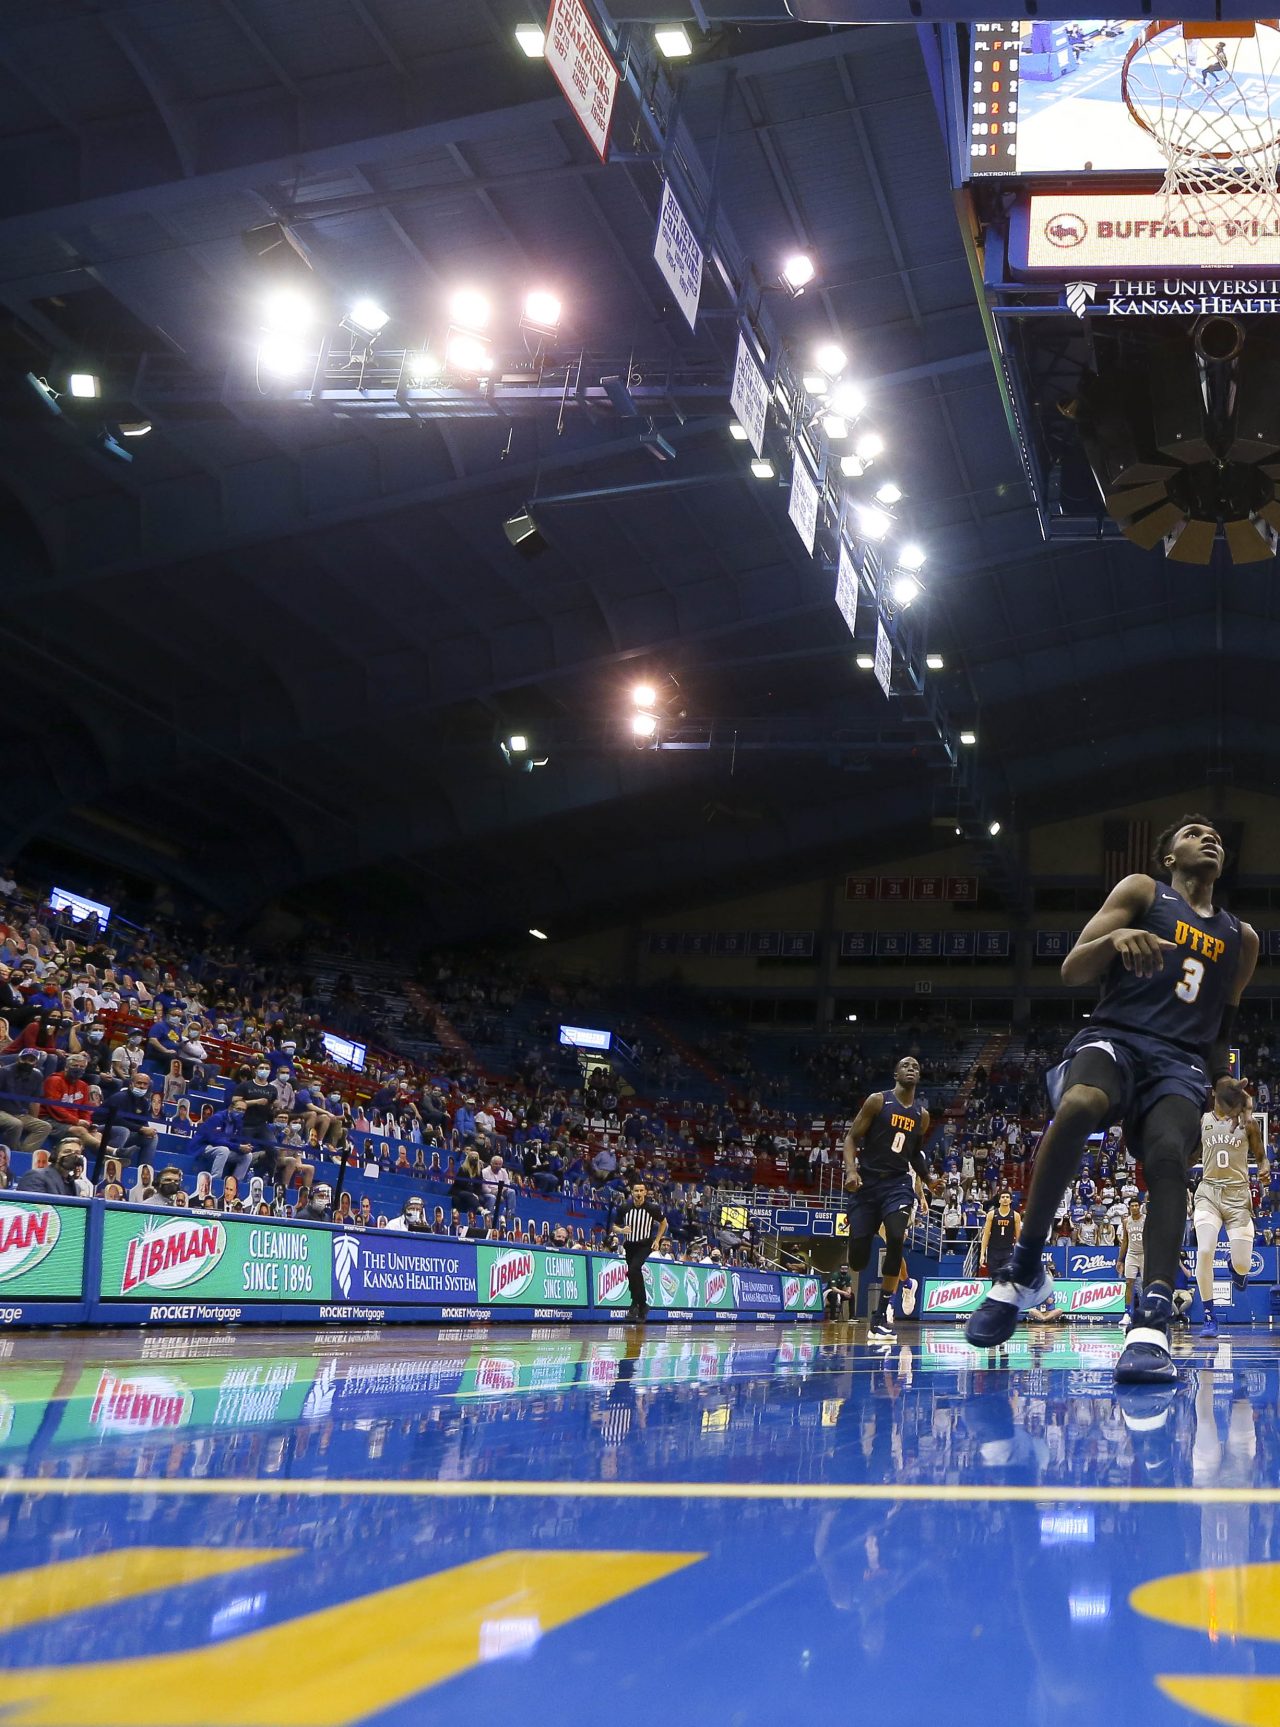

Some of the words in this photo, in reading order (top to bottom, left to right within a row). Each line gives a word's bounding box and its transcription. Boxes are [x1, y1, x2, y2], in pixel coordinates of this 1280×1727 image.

[558, 1, 610, 105] CHAMPIONS
[583, 22, 610, 80] EIGHT
[974, 42, 990, 51] PL
[994, 41, 1002, 50] F
[991, 102, 999, 114] 2
[989, 144, 996, 156] 1
[667, 191, 680, 224] BIG
[662, 205, 700, 285] CHAMPIONS
[1108, 279, 1156, 297] THE
[1107, 298, 1198, 316] KANSAS
[1175, 919, 1225, 963] UTEP
[1175, 956, 1205, 1004] 3
[890, 1113, 915, 1132] UTEP
[891, 1131, 906, 1154] 0
[1205, 1134, 1242, 1149] KANSAS
[1216, 1150, 1229, 1169] 0
[750, 1208, 772, 1217] KANSAS
[814, 1212, 833, 1220] GUEST
[1001, 1226, 1005, 1236] 1
[1131, 1233, 1143, 1242] 33
[249, 1229, 308, 1260] CLEANING
[120, 1226, 220, 1291] LIBMAN
[362, 1251, 386, 1270] THE
[387, 1253, 447, 1273] UNIVERSITY
[447, 1259, 459, 1274] OF
[545, 1256, 575, 1278] CLEANING
[1070, 1255, 1116, 1272] Dillons
[243, 1262, 279, 1291] SINCE
[282, 1264, 313, 1293] 1896
[363, 1270, 404, 1290] KANSAS
[406, 1273, 443, 1291] HEALTH
[444, 1275, 477, 1292] SYSTEM
[489, 1254, 531, 1299] LIBMAN
[543, 1279, 561, 1299] SINCE
[562, 1279, 578, 1299] 1896
[705, 1275, 726, 1305] LIBMAN
[784, 1281, 800, 1307] LIBMAN
[804, 1283, 817, 1308] LIBMAN
[928, 1284, 979, 1309] LIBMAN
[1071, 1284, 1122, 1310] LIBMAN
[150, 1306, 196, 1320] ROCKET
[196, 1306, 242, 1322] Mortgage
[319, 1306, 352, 1318] ROCKET
[352, 1307, 385, 1320] Mortgage
[441, 1308, 467, 1318] ROCKET
[466, 1308, 491, 1320] Mortgage
[534, 1309, 554, 1318] ROCKET
[553, 1309, 573, 1320] Mortgage
